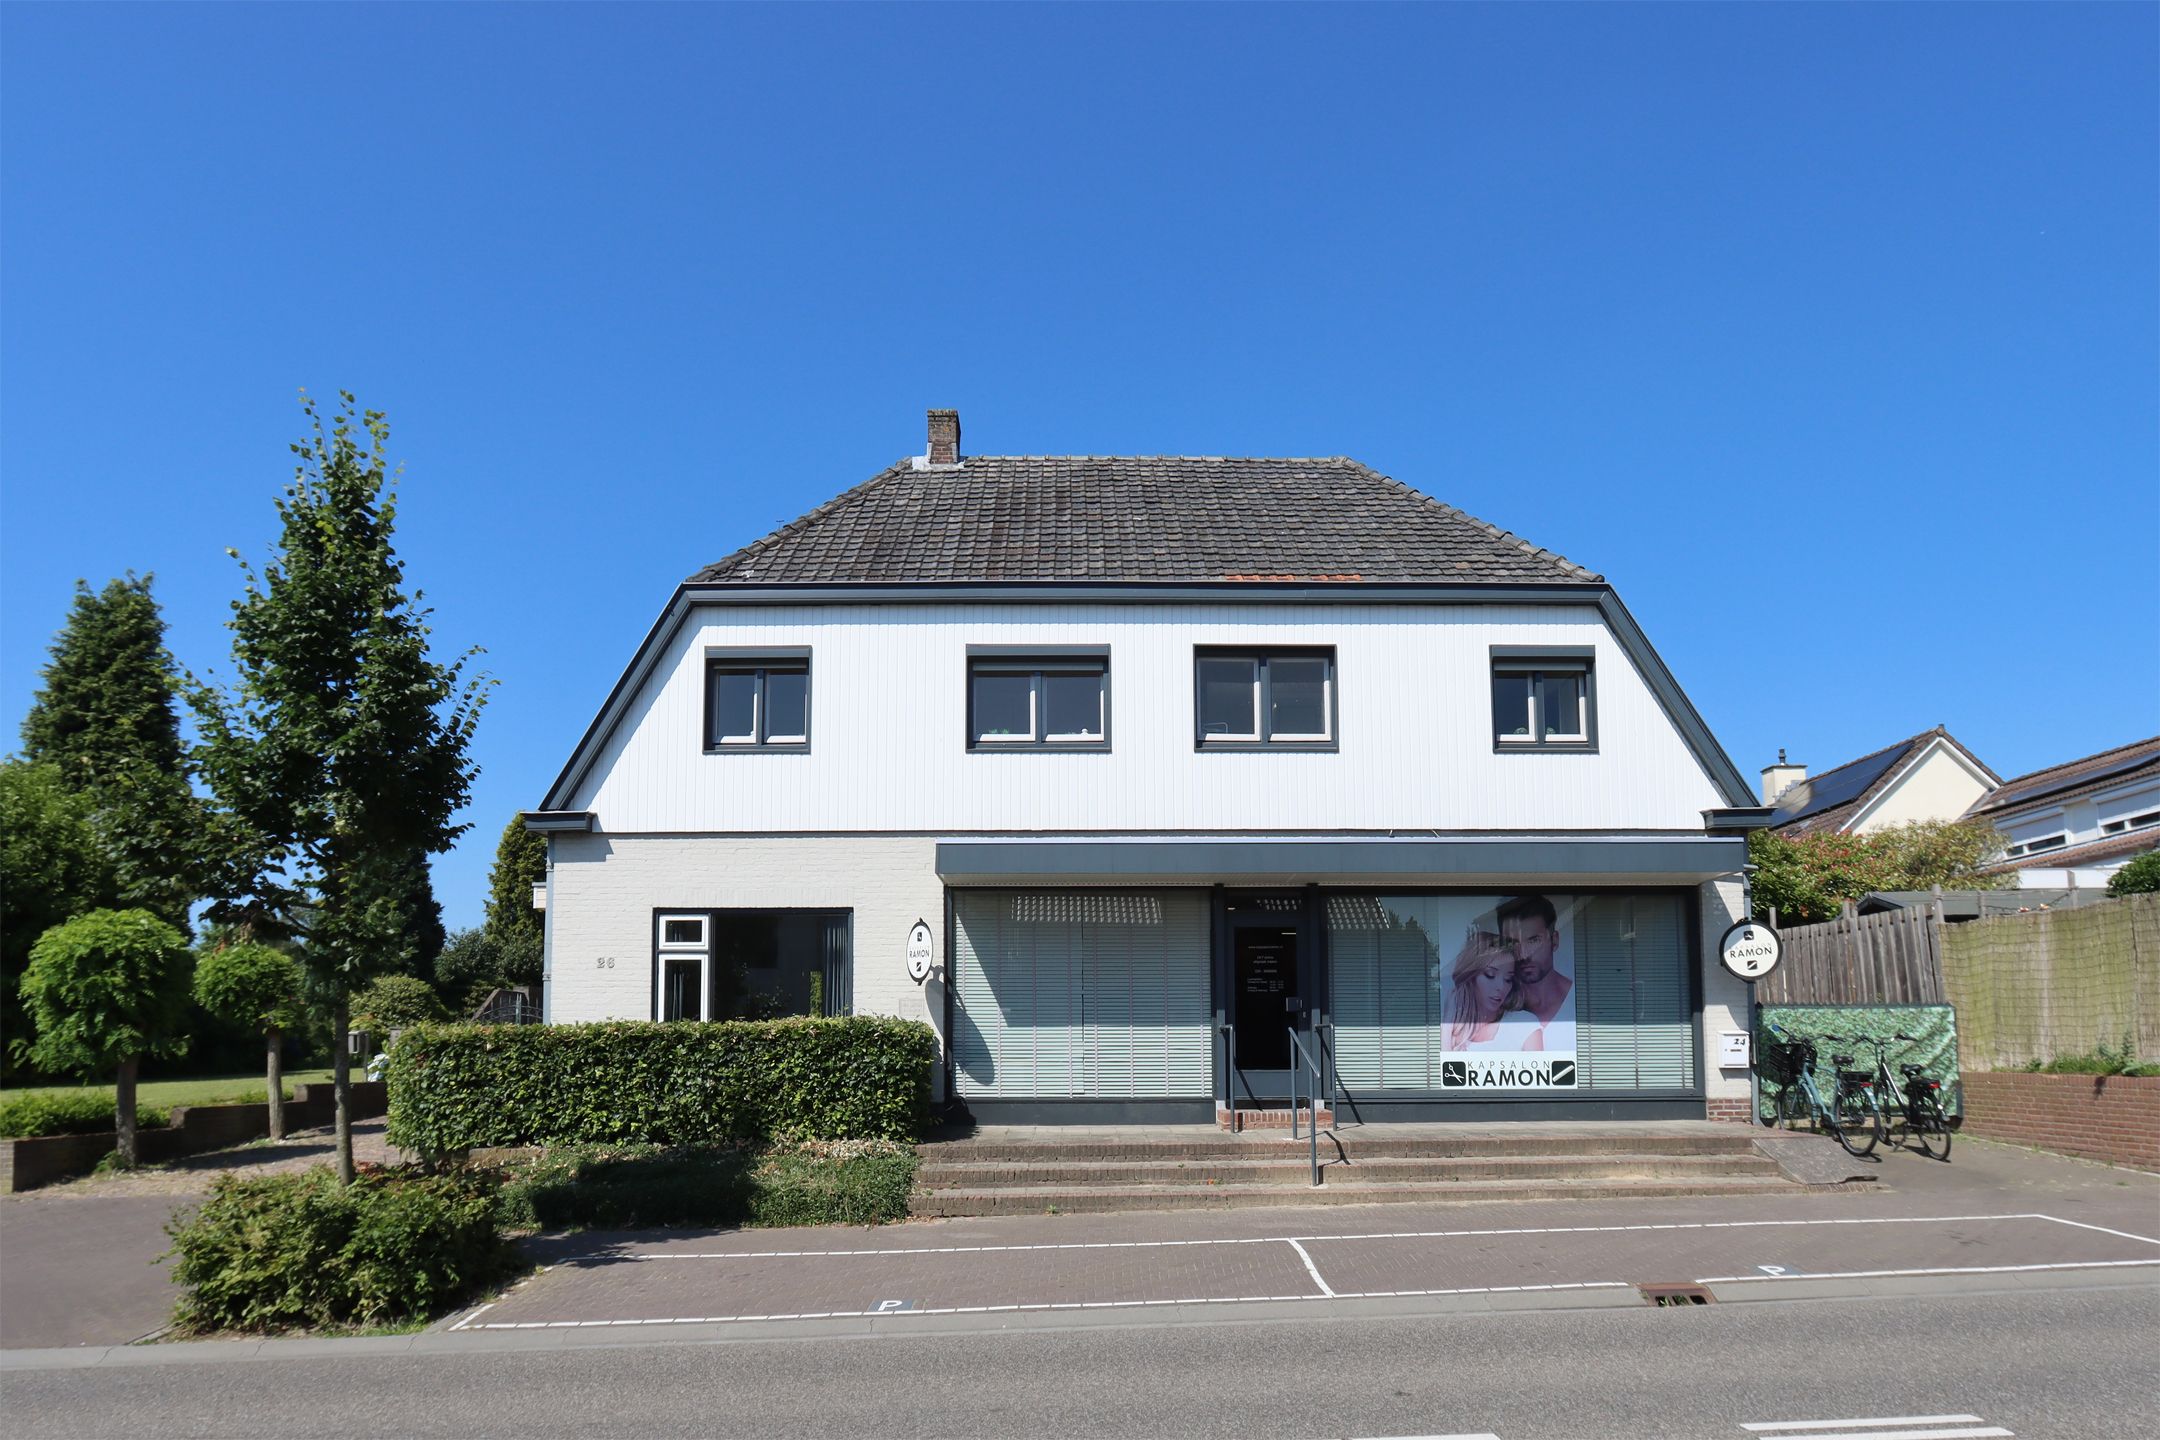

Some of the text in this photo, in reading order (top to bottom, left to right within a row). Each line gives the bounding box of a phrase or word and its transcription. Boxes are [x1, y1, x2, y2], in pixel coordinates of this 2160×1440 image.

[909, 949, 930, 958] RAMON
[1730, 947, 1773, 959] RAMON
[597, 957, 615, 969] 26
[1468, 1061, 1551, 1069] KAPSALON
[1468, 1070, 1551, 1087] RAMON
[878, 1300, 902, 1311] P
